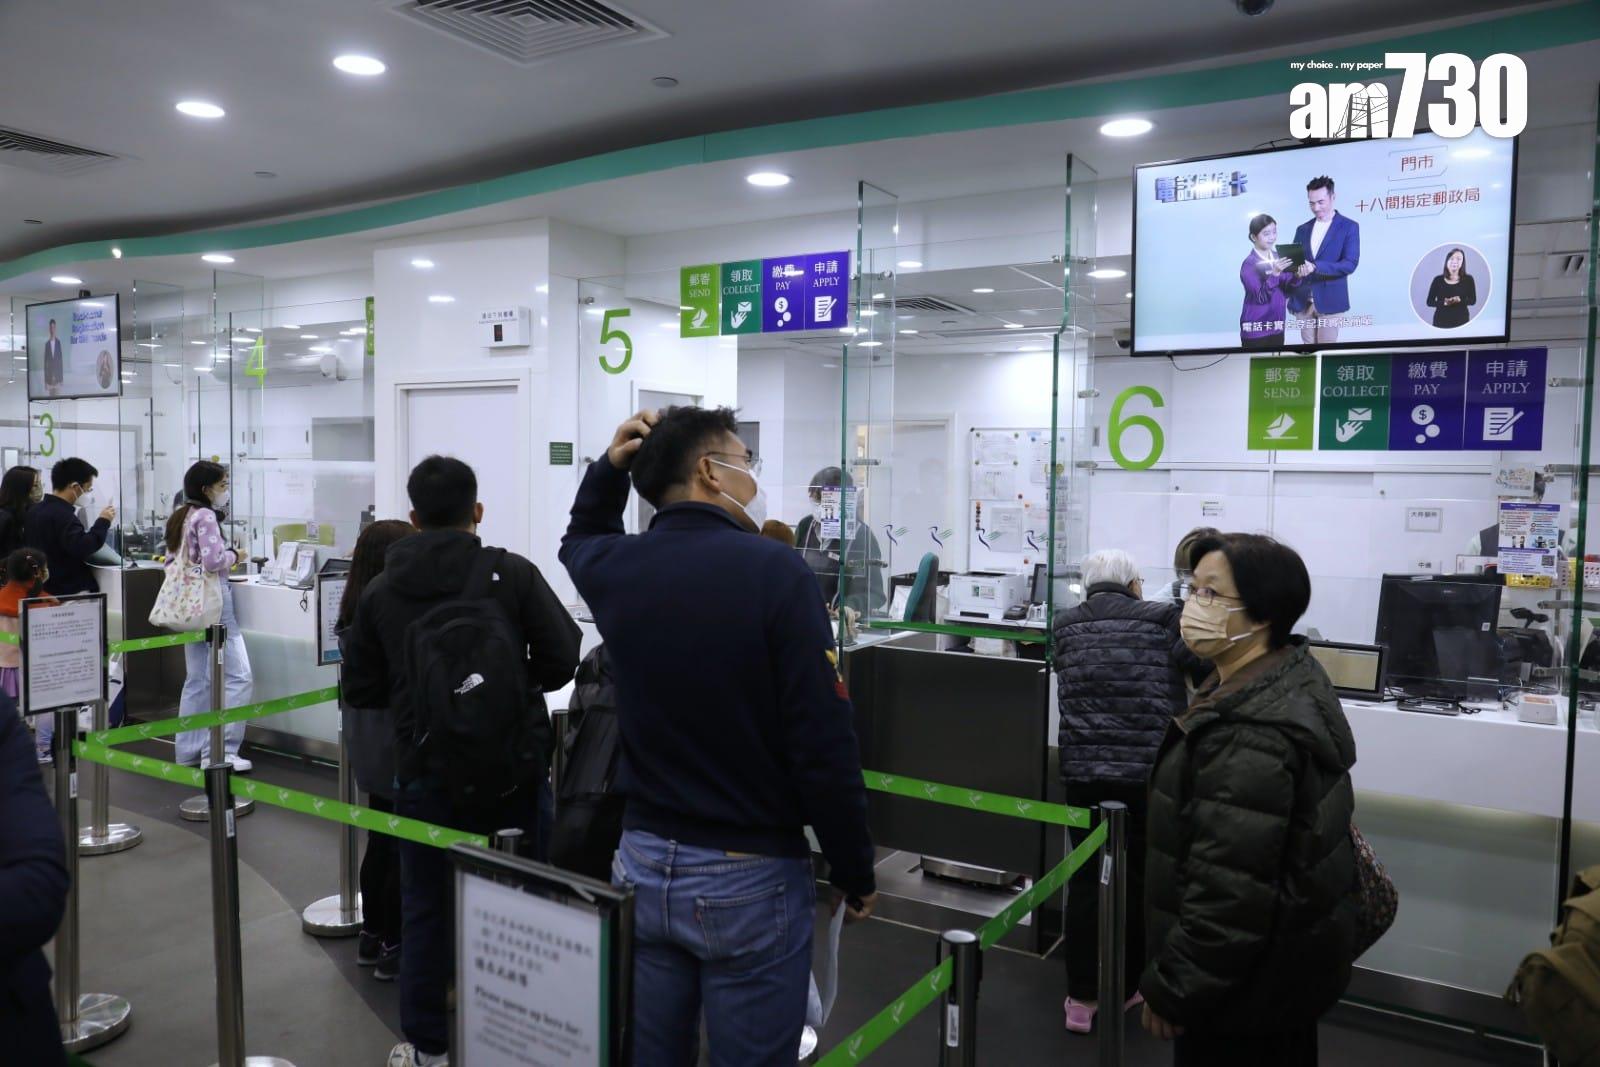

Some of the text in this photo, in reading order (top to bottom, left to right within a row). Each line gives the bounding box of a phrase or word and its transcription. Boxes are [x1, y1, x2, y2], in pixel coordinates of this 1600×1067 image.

[1401, 155, 1433, 172] 門市
[1355, 187, 1480, 213] 十八間指定郵政局
[814, 260, 839, 275] 申請
[730, 269, 753, 283] 領取
[812, 276, 840, 288] APPLY
[689, 288, 711, 298] SEND
[722, 283, 761, 296] COLLECT
[775, 280, 792, 291] PAY
[599, 307, 633, 375] 5
[243, 335, 268, 385] 4
[1264, 367, 1301, 383] 郵寄
[1336, 365, 1375, 381] 領取
[1408, 361, 1448, 379] 繳費
[1486, 360, 1529, 378] 申請
[1263, 387, 1301, 399] SEND
[1322, 385, 1389, 398] COLLECT
[1414, 383, 1440, 396] PAY
[1481, 382, 1531, 395] APPLY
[39, 412, 55, 457] 3
[1107, 385, 1165, 472] 6
